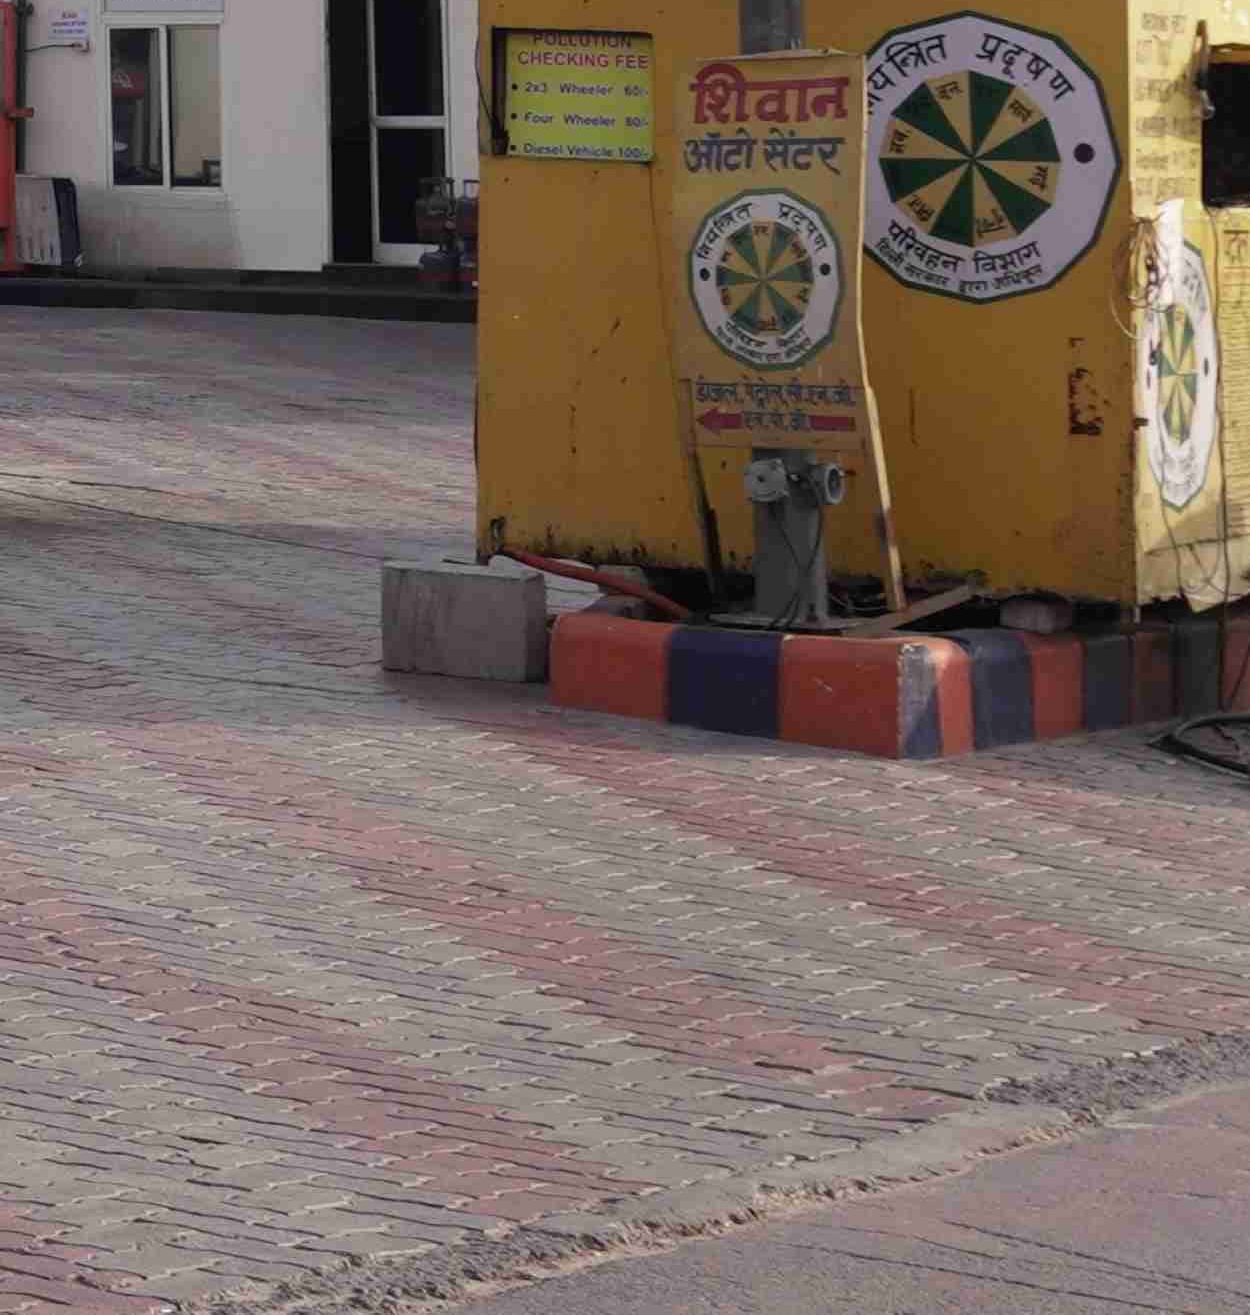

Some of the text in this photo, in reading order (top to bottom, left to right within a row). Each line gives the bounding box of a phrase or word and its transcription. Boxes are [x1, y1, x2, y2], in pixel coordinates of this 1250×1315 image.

[517, 50, 649, 69] CHECKING FEE
[976, 33, 1075, 99] प्रदूषण
[973, 241, 1041, 273] विभाग
